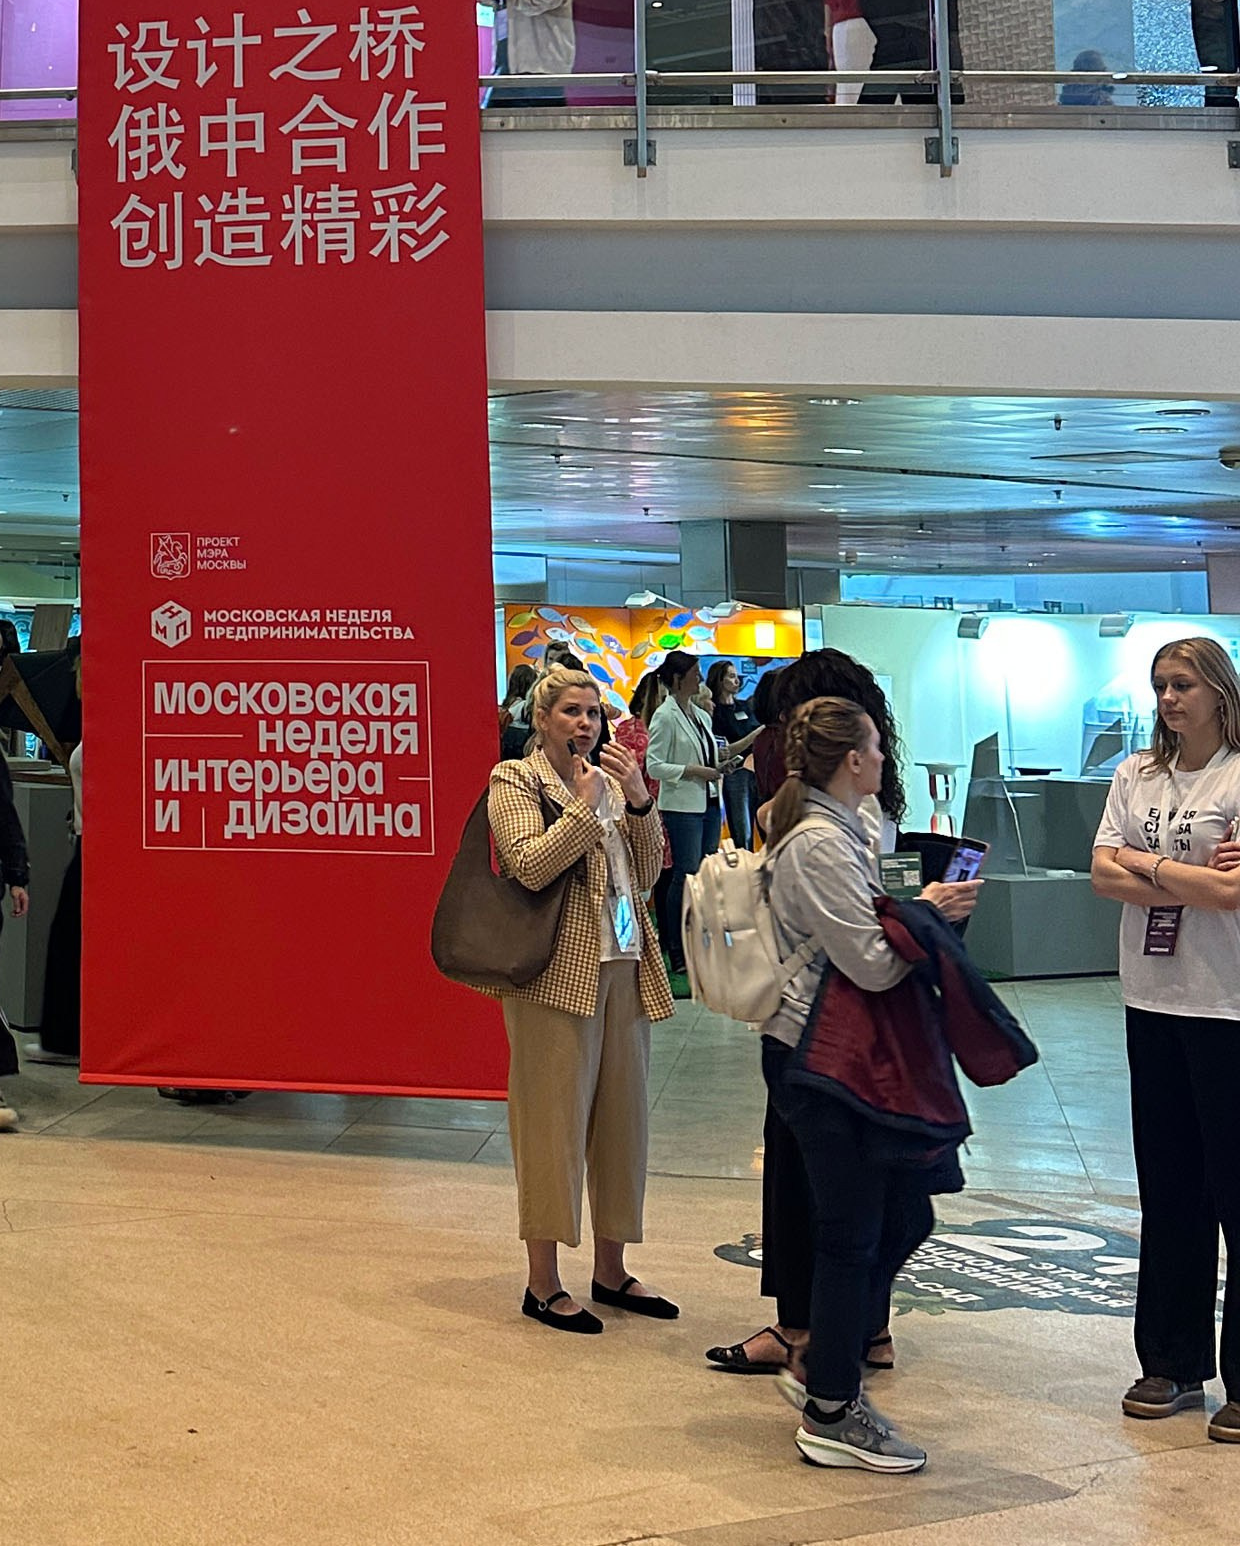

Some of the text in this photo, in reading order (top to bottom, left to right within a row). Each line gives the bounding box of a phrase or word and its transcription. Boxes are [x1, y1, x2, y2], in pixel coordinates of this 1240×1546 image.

[107, 4, 427, 94] 设计之桥
[107, 89, 449, 184] 俄中合作
[109, 181, 452, 270] 创造精彩
[196, 536, 241, 547] ПРОЕКТ
[196, 548, 229, 559] МЭРА
[196, 559, 247, 570] МОСКВЫ
[203, 609, 392, 624] МОСКОВСКАЯ НЕДЕЛЯ
[203, 626, 416, 642] ПРЕДПРИНИМАТЕЛЬСТВА
[258, 719, 420, 760] неделя
[154, 758, 384, 801] интерьера
[223, 797, 421, 839] дизайна
[1028, 1262, 1122, 1289] ЭТАЖ
